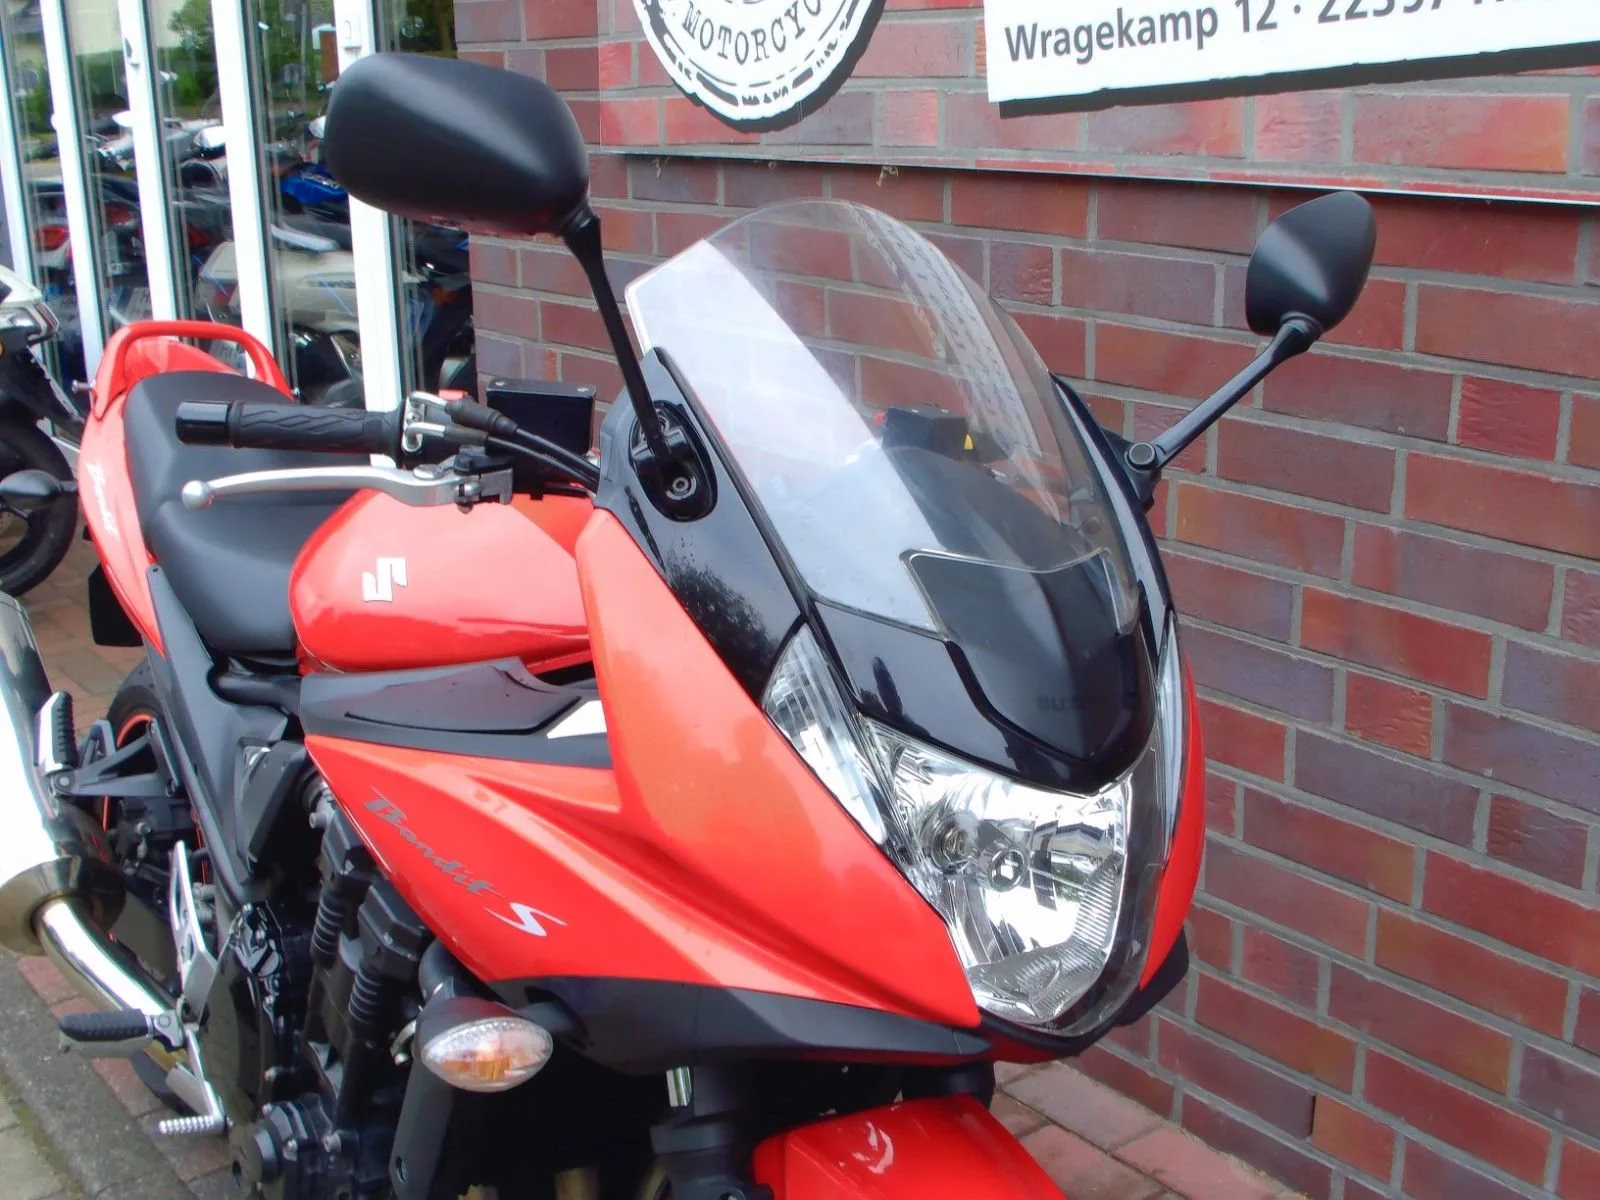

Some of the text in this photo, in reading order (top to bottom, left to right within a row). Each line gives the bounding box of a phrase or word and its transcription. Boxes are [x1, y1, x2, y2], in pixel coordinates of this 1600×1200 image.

[1005, 5, 1218, 65] Wragekamp
[1235, 0, 1278, 32] 12
[363, 785, 568, 937] Bandit S
